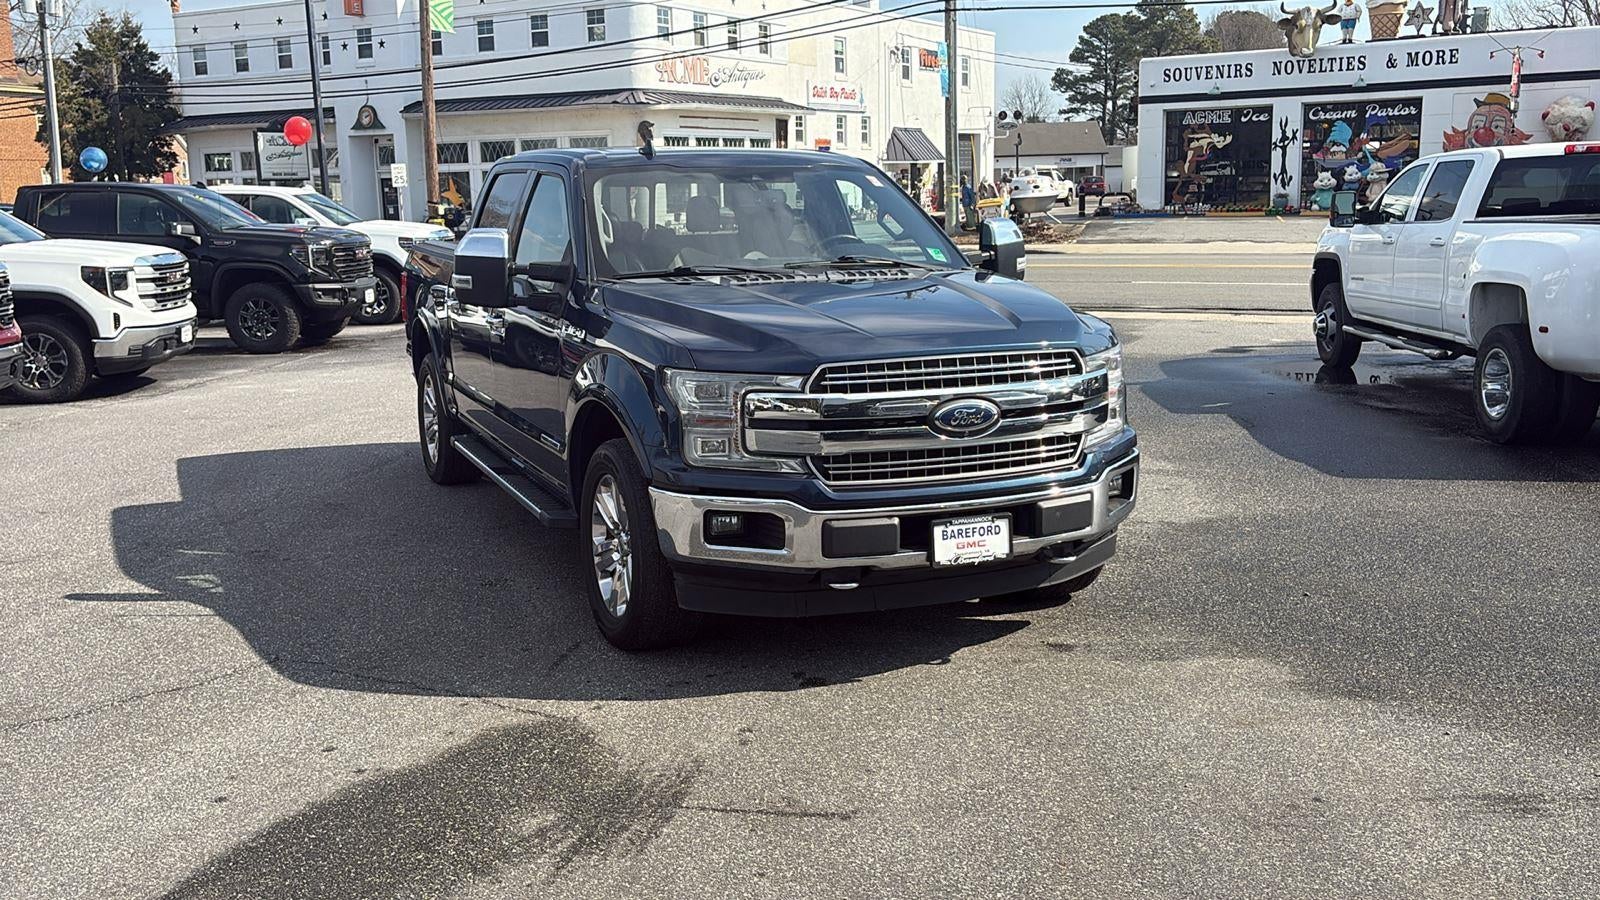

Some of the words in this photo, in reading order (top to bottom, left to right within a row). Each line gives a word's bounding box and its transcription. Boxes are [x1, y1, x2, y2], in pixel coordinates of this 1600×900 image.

[655, 55, 710, 85] ACME
[710, 61, 766, 88] Antiques
[1163, 62, 1254, 83] SOUVENIRS
[1271, 55, 1367, 76] NOVELTIES
[1386, 53, 1398, 69] &
[1406, 48, 1460, 68] MORE
[812, 85, 827, 98] Dutch
[829, 86, 839, 101] Boy
[840, 87, 857, 101] Paints
[1182, 109, 1232, 125] ACME
[1240, 108, 1271, 123] Ice
[1308, 106, 1358, 121] Cream
[1365, 103, 1419, 118] Parlor
[394, 175, 405, 184] 25
[950, 408, 985, 426] Ford
[951, 515, 993, 526] TAPPAHANNOCK
[941, 524, 1001, 541] BAREFORD
[956, 539, 987, 550] GMC
